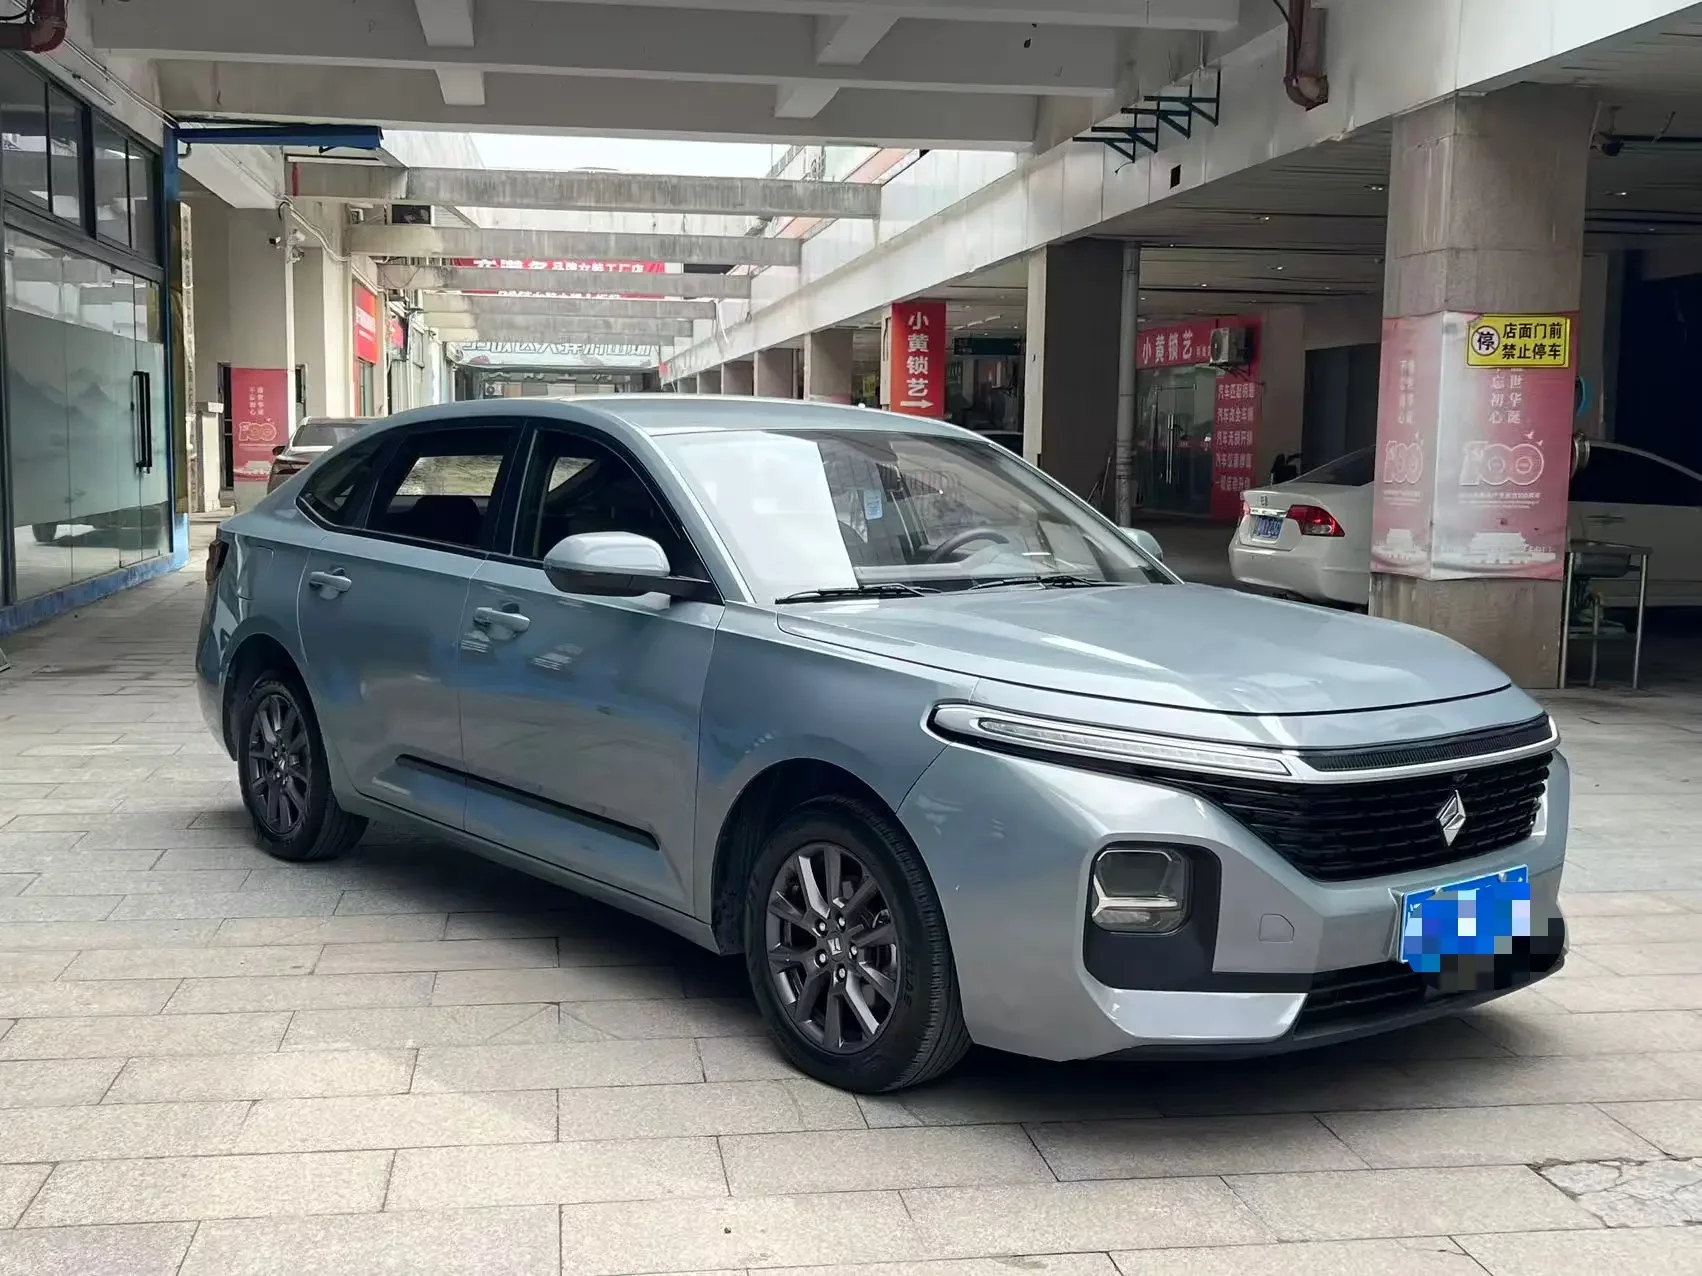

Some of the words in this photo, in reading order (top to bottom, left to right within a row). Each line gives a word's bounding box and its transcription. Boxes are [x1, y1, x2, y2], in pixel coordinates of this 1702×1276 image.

[1142, 328, 1193, 365] 小黄锁艺
[1503, 322, 1563, 339] 店面门前
[906, 311, 929, 397] 小黄锁艺
[1502, 343, 1562, 360] 禁止停车
[1489, 368, 1505, 424] 忘初心
